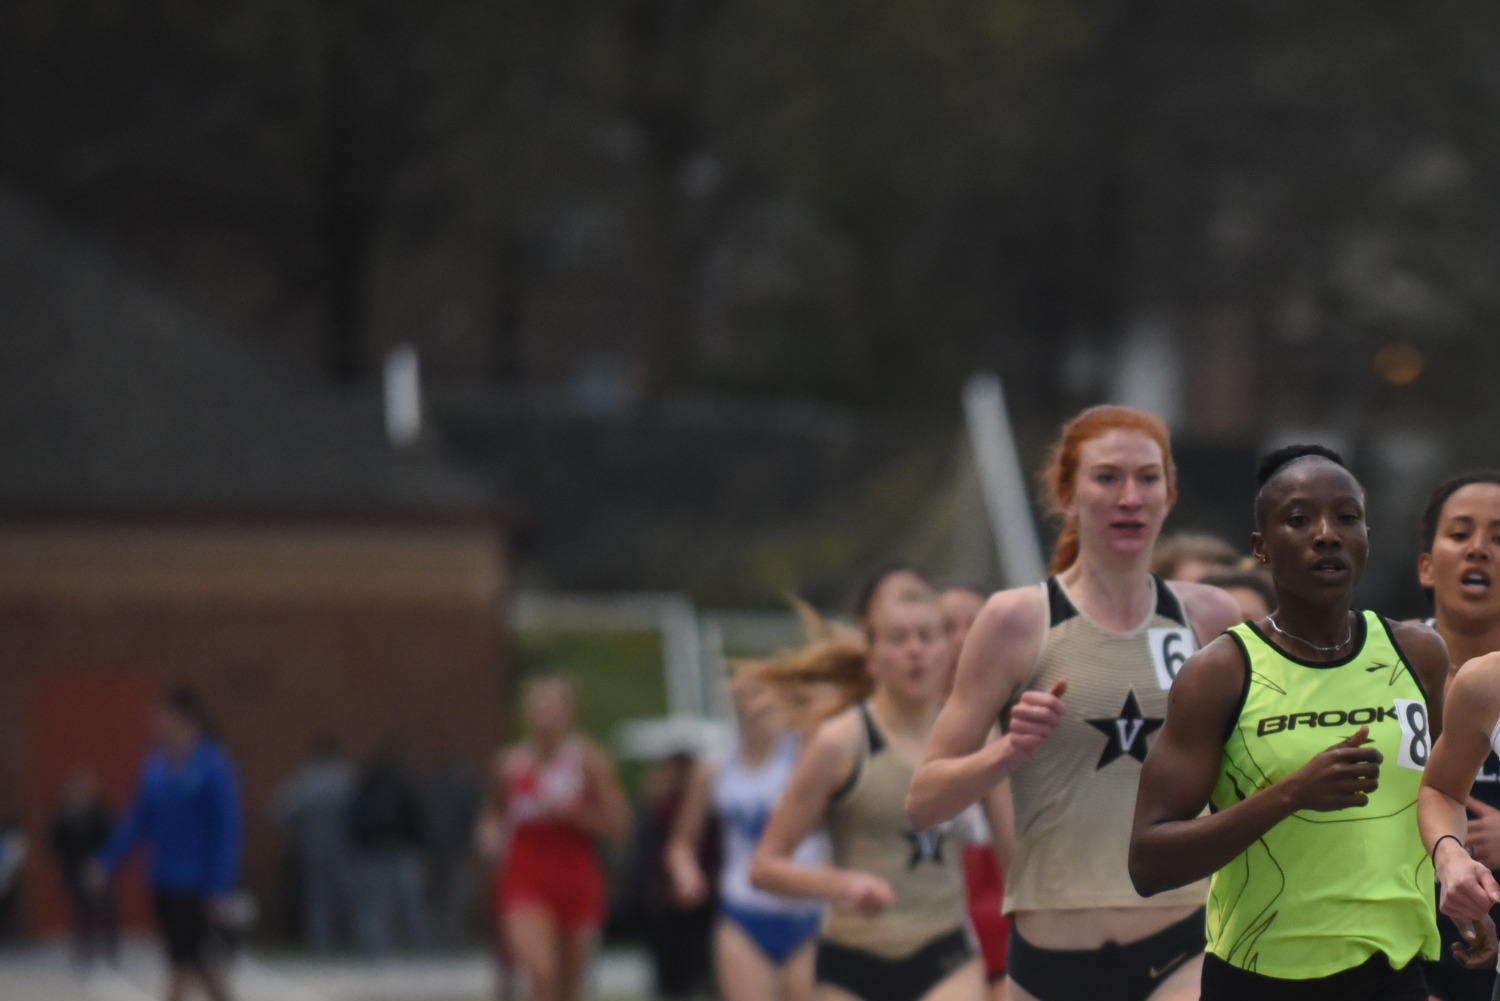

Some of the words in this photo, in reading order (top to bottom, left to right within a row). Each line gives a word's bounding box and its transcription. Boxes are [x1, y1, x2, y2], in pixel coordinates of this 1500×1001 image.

[1162, 632, 1186, 681] 6
[1115, 718, 1145, 753] V
[1257, 705, 1399, 737] BROOK
[1406, 702, 1428, 767] 8
